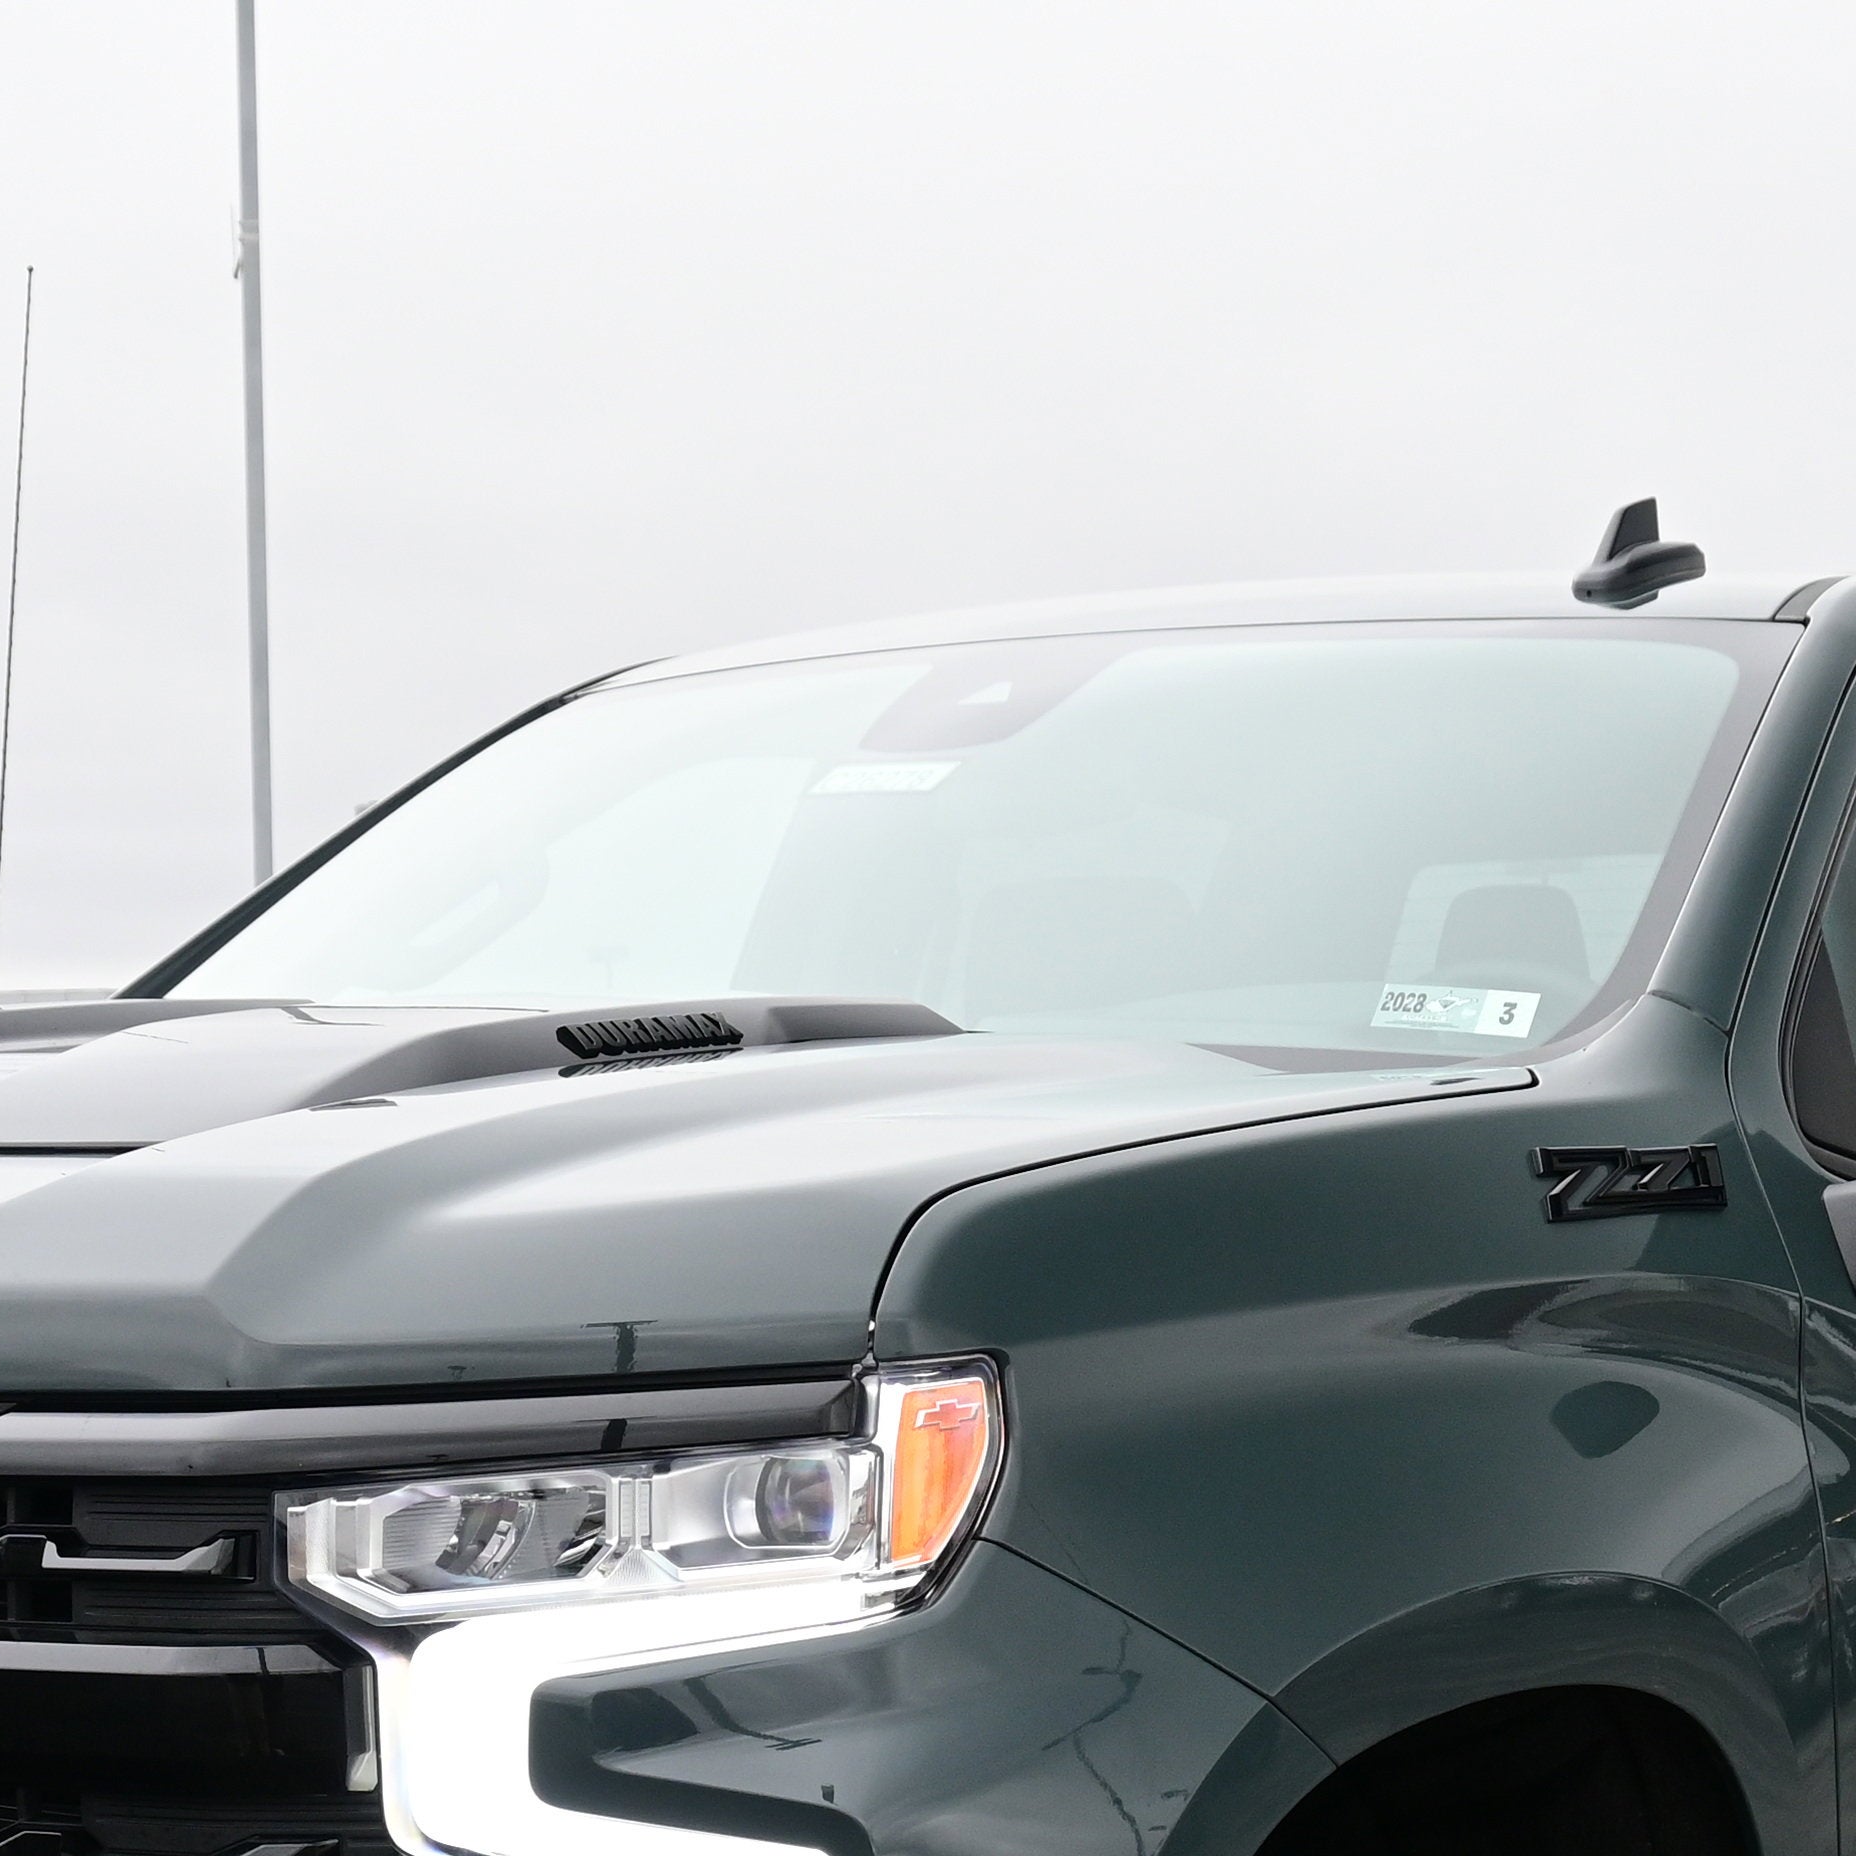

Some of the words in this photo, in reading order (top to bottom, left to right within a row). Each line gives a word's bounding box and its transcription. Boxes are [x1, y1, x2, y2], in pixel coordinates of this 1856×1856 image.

[1380, 991, 1427, 1014] 2028
[1498, 1001, 1518, 1026] 3
[559, 1011, 743, 1055] DURAMAX
[1530, 1143, 1728, 1223] Z71
